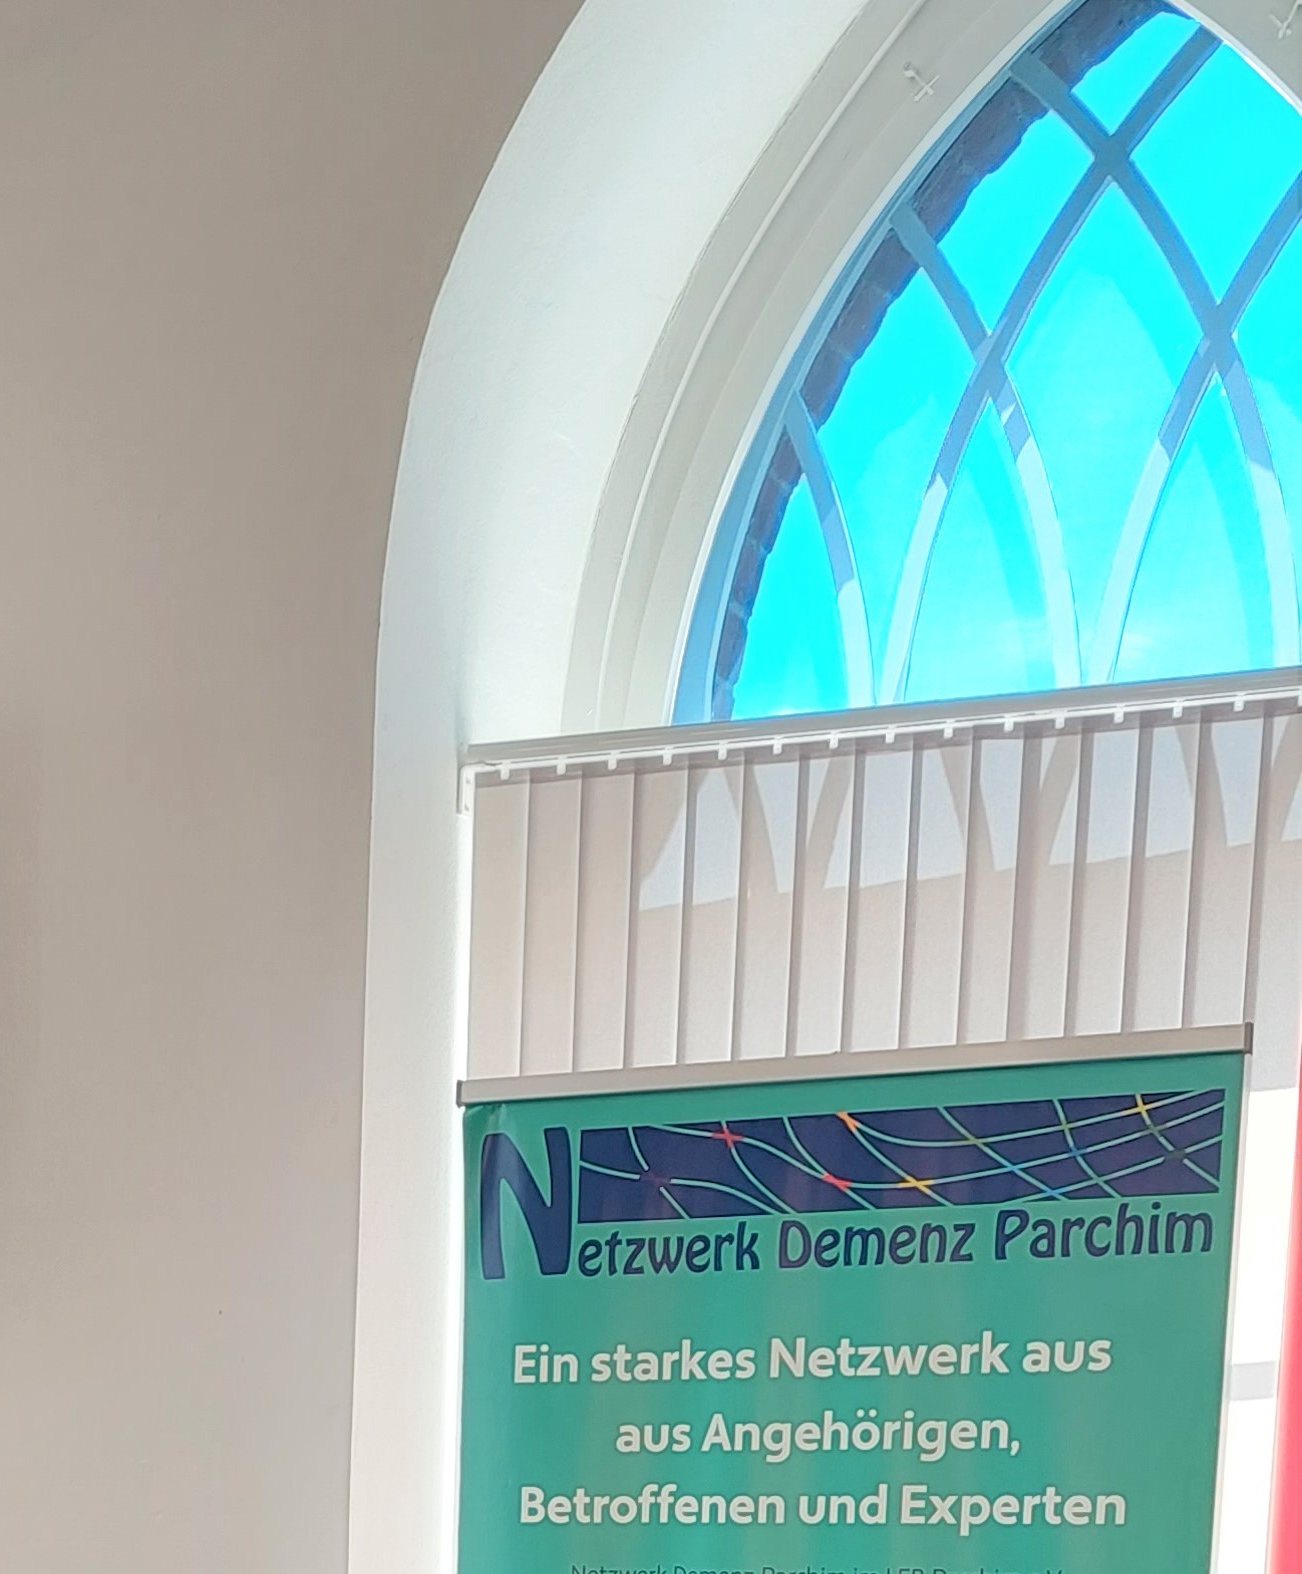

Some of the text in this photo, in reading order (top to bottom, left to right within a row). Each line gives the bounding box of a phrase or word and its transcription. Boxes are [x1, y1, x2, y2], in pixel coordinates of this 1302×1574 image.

[479, 1126, 1214, 1280] Netzwerk Demenz Parchim
[513, 1330, 1112, 1384] Ein starkes Netzwerk aus
[615, 1408, 1020, 1462] aus Angehörigen,
[520, 1483, 1127, 1537] Betroffenen und Experten
